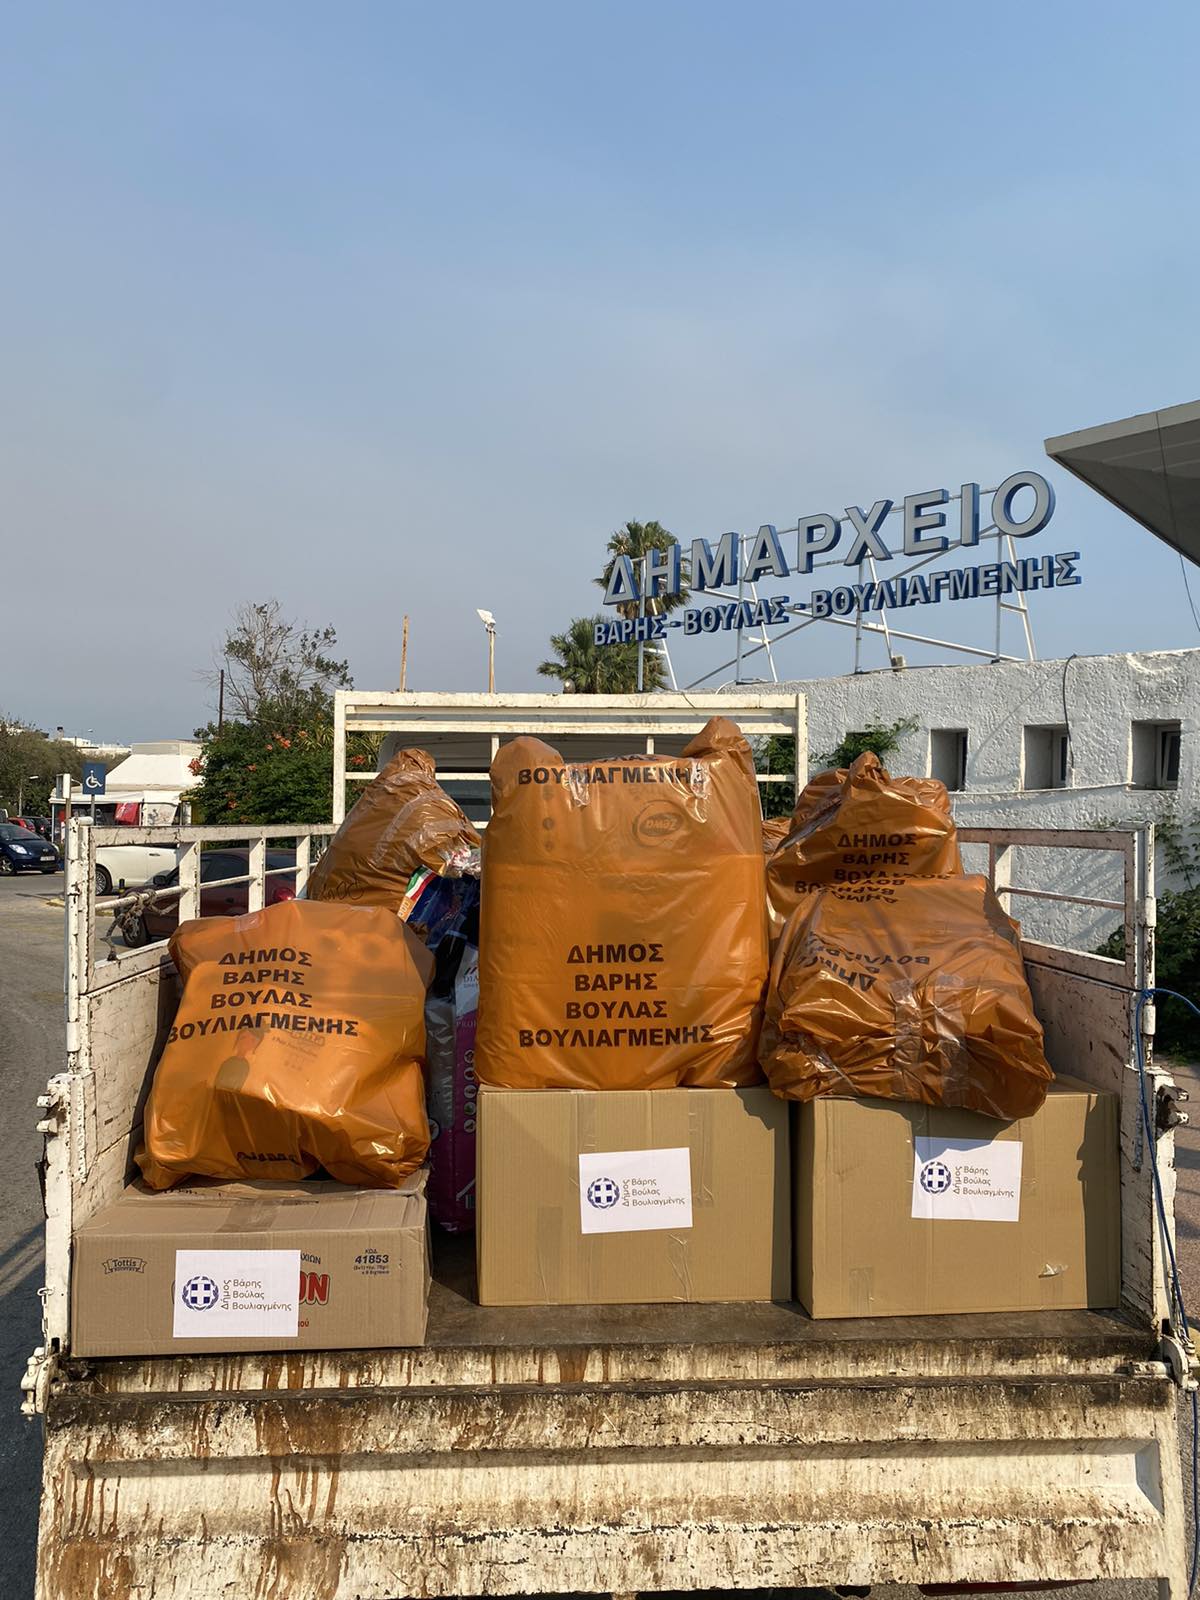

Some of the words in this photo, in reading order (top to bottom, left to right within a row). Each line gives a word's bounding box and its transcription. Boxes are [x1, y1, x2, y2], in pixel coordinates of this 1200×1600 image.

[603, 470, 1056, 605] ΔΗΜΑΡΧΕΙΟ
[837, 833, 917, 848] ΔΗΜΟΣ
[842, 852, 909, 866] ΒΑΡΗΣ
[218, 948, 313, 967] ΔΗΜΟΣ
[567, 943, 664, 964] ΔΗΜΟΣ
[223, 969, 304, 986] ΒΑΡΗΣ
[574, 973, 658, 991] ΒΑΡΗΣ
[211, 989, 312, 1009] ΒΟΥΛΑΣ
[566, 1000, 667, 1020] ΒΟΥΛΑΣ
[168, 1012, 359, 1045] ΒΟΥΛΙΑΓΜΕΝΗΣ
[519, 1024, 714, 1048] ΒΟΥΛΙΑΓΜΕΝΗΣ
[964, 1166, 989, 1175] Βάρης
[631, 1178, 657, 1187] Βάρης
[963, 1177, 991, 1186] Βούλας
[632, 1188, 660, 1196] Βούλας
[963, 1188, 1014, 1198] Βουλιαγμένης
[632, 1197, 685, 1207] Βουλιαγμένης
[355, 1254, 389, 1264] 41853
[233, 1279, 262, 1288] Βάρης
[221, 1279, 232, 1310] Δήμος
[232, 1290, 265, 1300] Βούλας
[232, 1302, 292, 1312] Βουλιαγμένης
